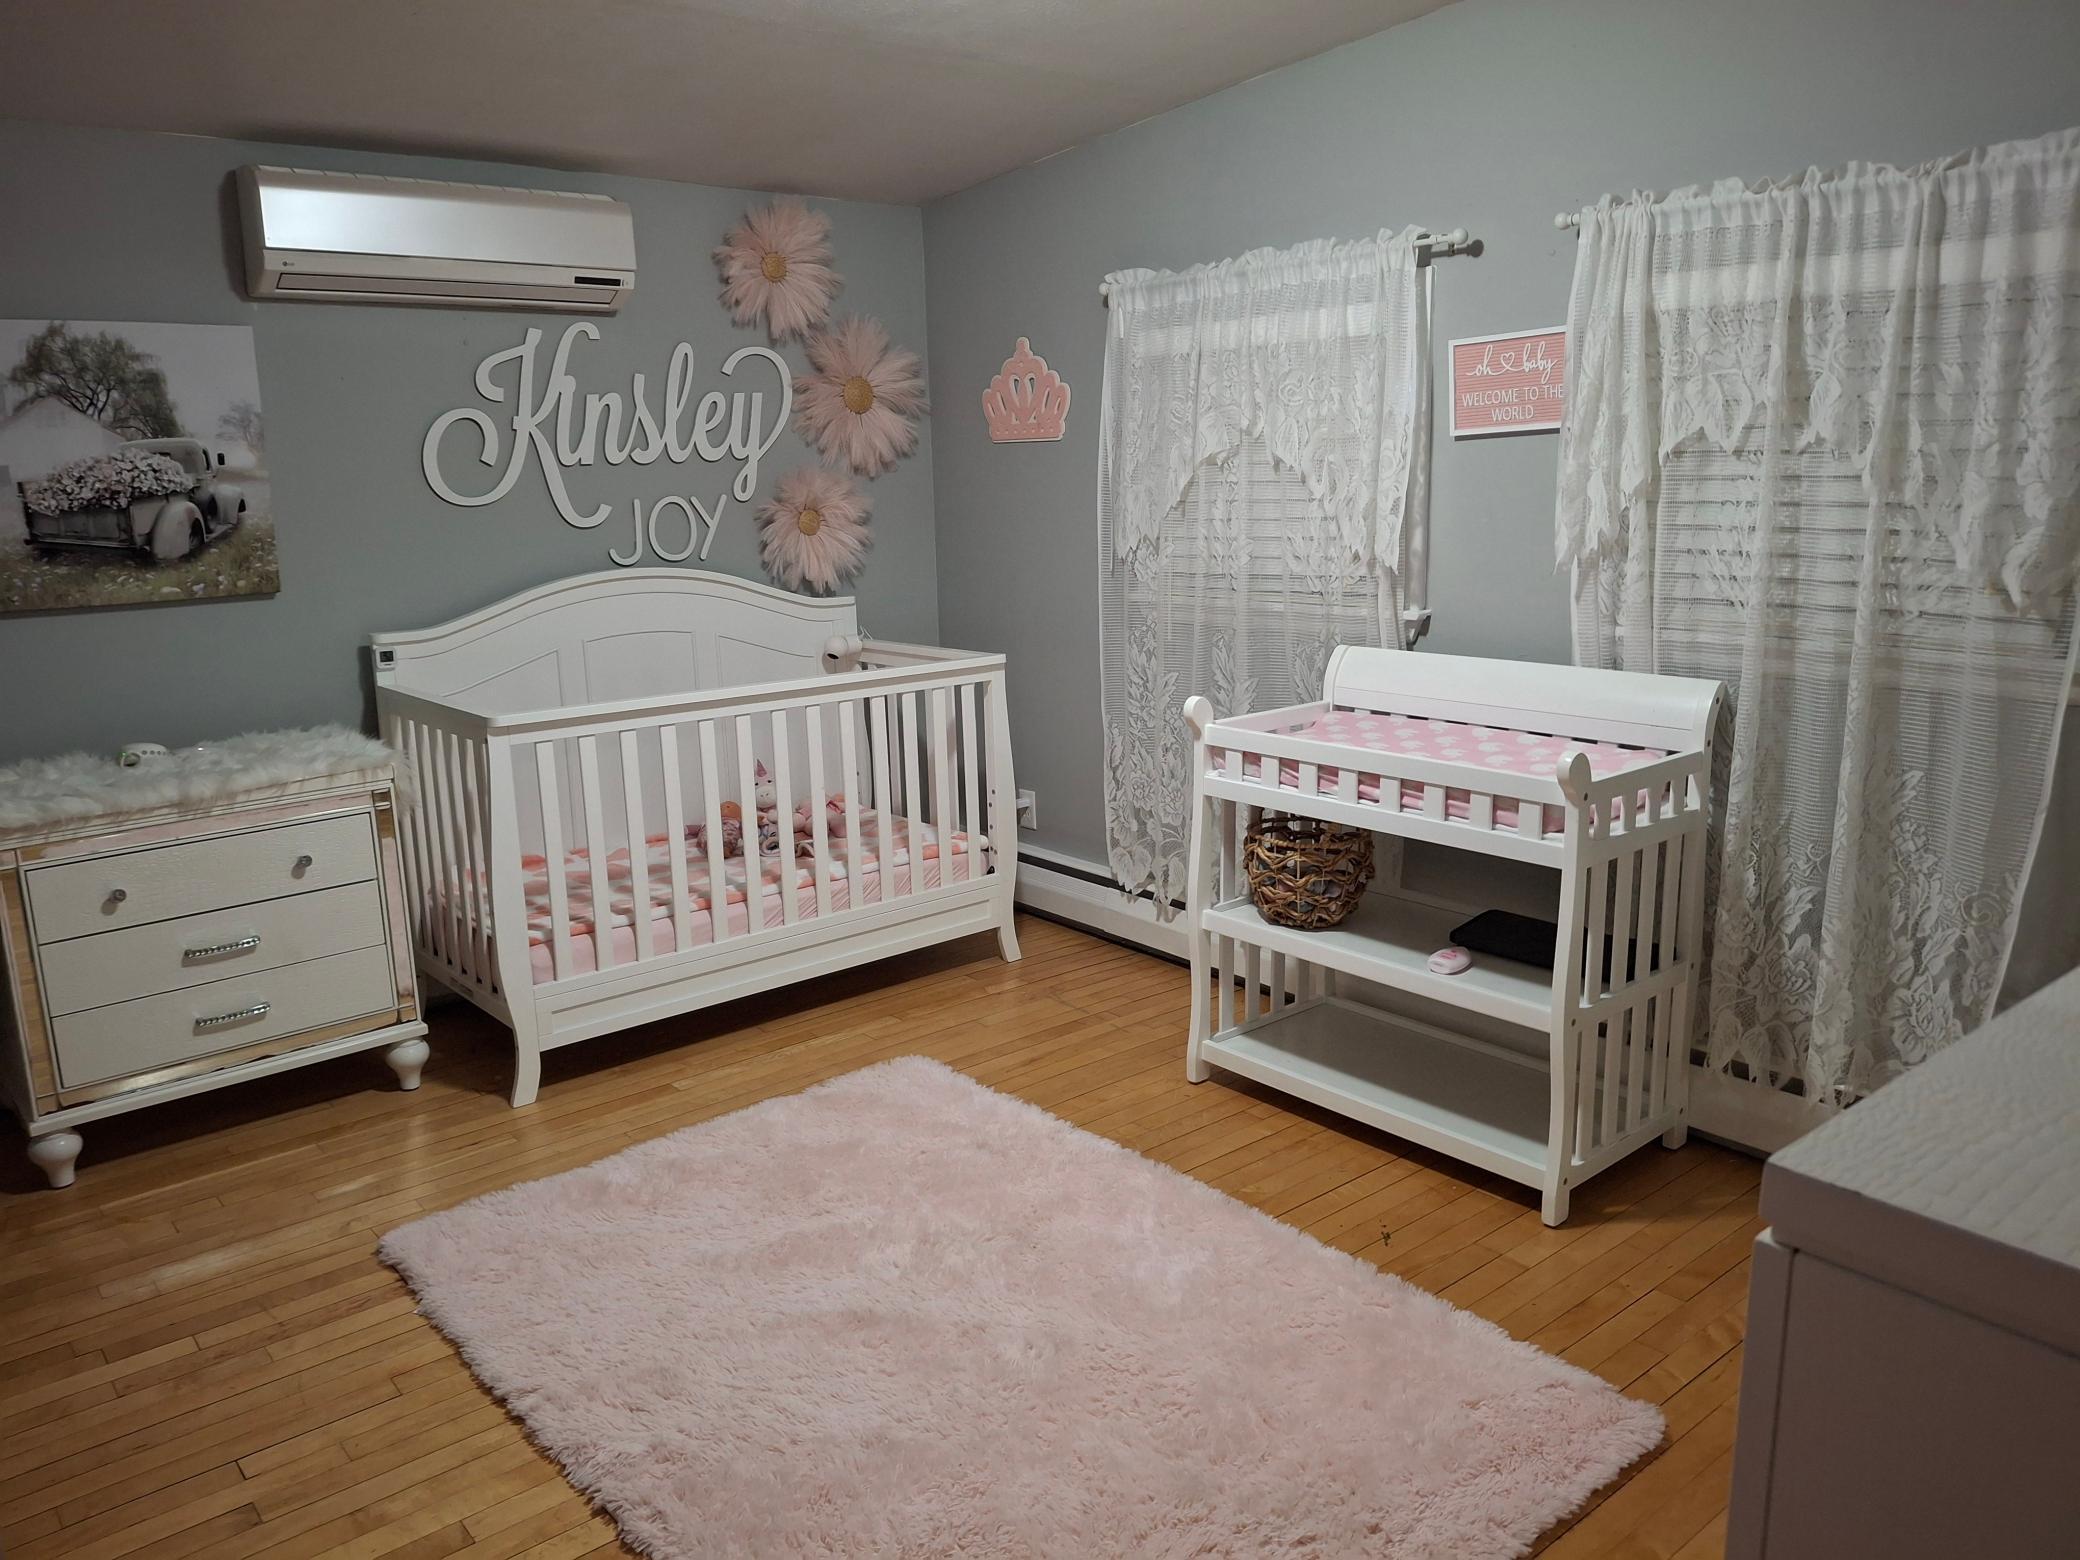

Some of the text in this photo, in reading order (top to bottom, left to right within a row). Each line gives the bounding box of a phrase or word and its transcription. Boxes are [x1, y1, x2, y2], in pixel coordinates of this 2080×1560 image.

[1466, 341, 1558, 384] oh baby
[1462, 383, 1565, 407] WELCOME TO THE
[1491, 405, 1534, 422] WORLD
[422, 321, 793, 528] Kinsley
[608, 494, 727, 566] JOY
